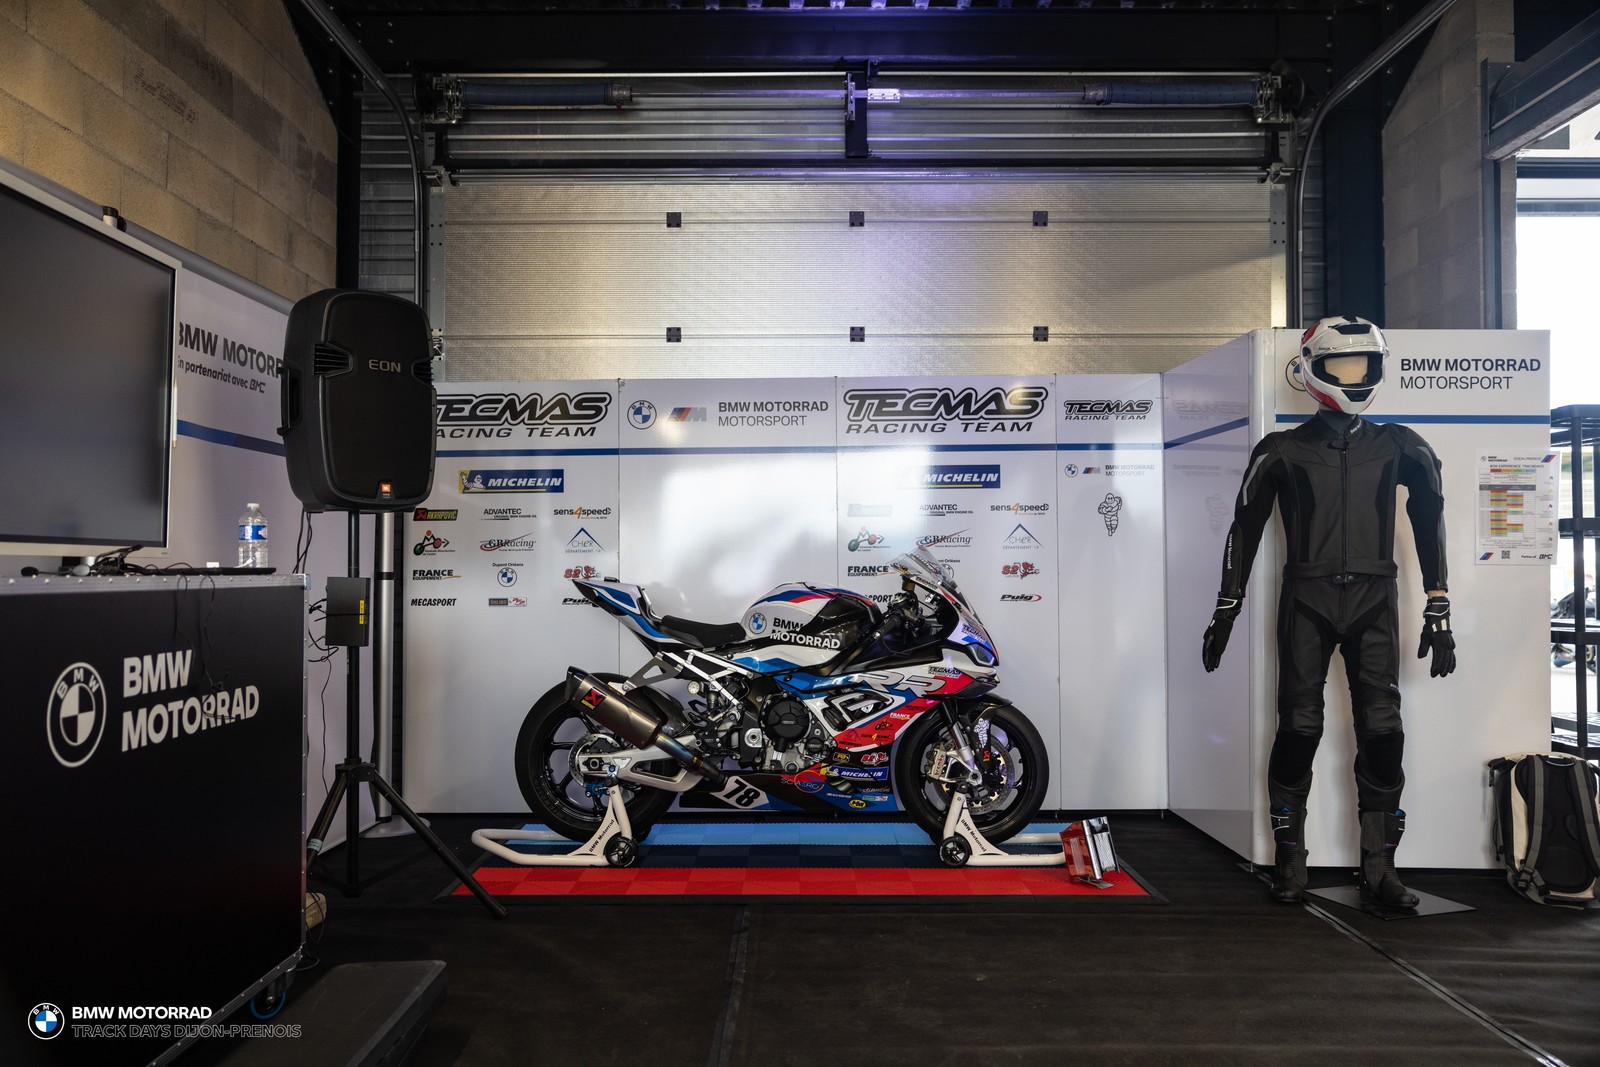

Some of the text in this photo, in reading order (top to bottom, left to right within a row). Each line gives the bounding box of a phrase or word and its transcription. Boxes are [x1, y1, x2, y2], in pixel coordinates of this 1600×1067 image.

[368, 359, 401, 373] EON
[1400, 358, 1541, 372] BMW MOTORRAD
[185, 361, 232, 384] partenariat
[231, 375, 249, 389] avec
[1400, 376, 1513, 390] MOTORSPORT
[436, 392, 612, 426] ECMAS
[718, 401, 829, 413] BMW MOTORRAD
[843, 386, 1049, 422] TECMAS
[1064, 400, 1153, 415] TECMAS
[718, 415, 808, 427] MOTORSPORT
[845, 421, 1033, 434] RACING TEAM
[436, 426, 596, 439] ACING TEAM
[488, 477, 562, 487] MICHELIN
[922, 473, 999, 483] MICHELIN
[412, 569, 454, 577] FRANCE
[847, 565, 889, 573] FRANCE
[411, 598, 457, 607] MECASPORT
[773, 617, 804, 631] BMW
[770, 629, 841, 649] MOTORRAD
[123, 649, 193, 698] BMW
[121, 685, 261, 753] MOTORRAD
[723, 778, 761, 807] 78
